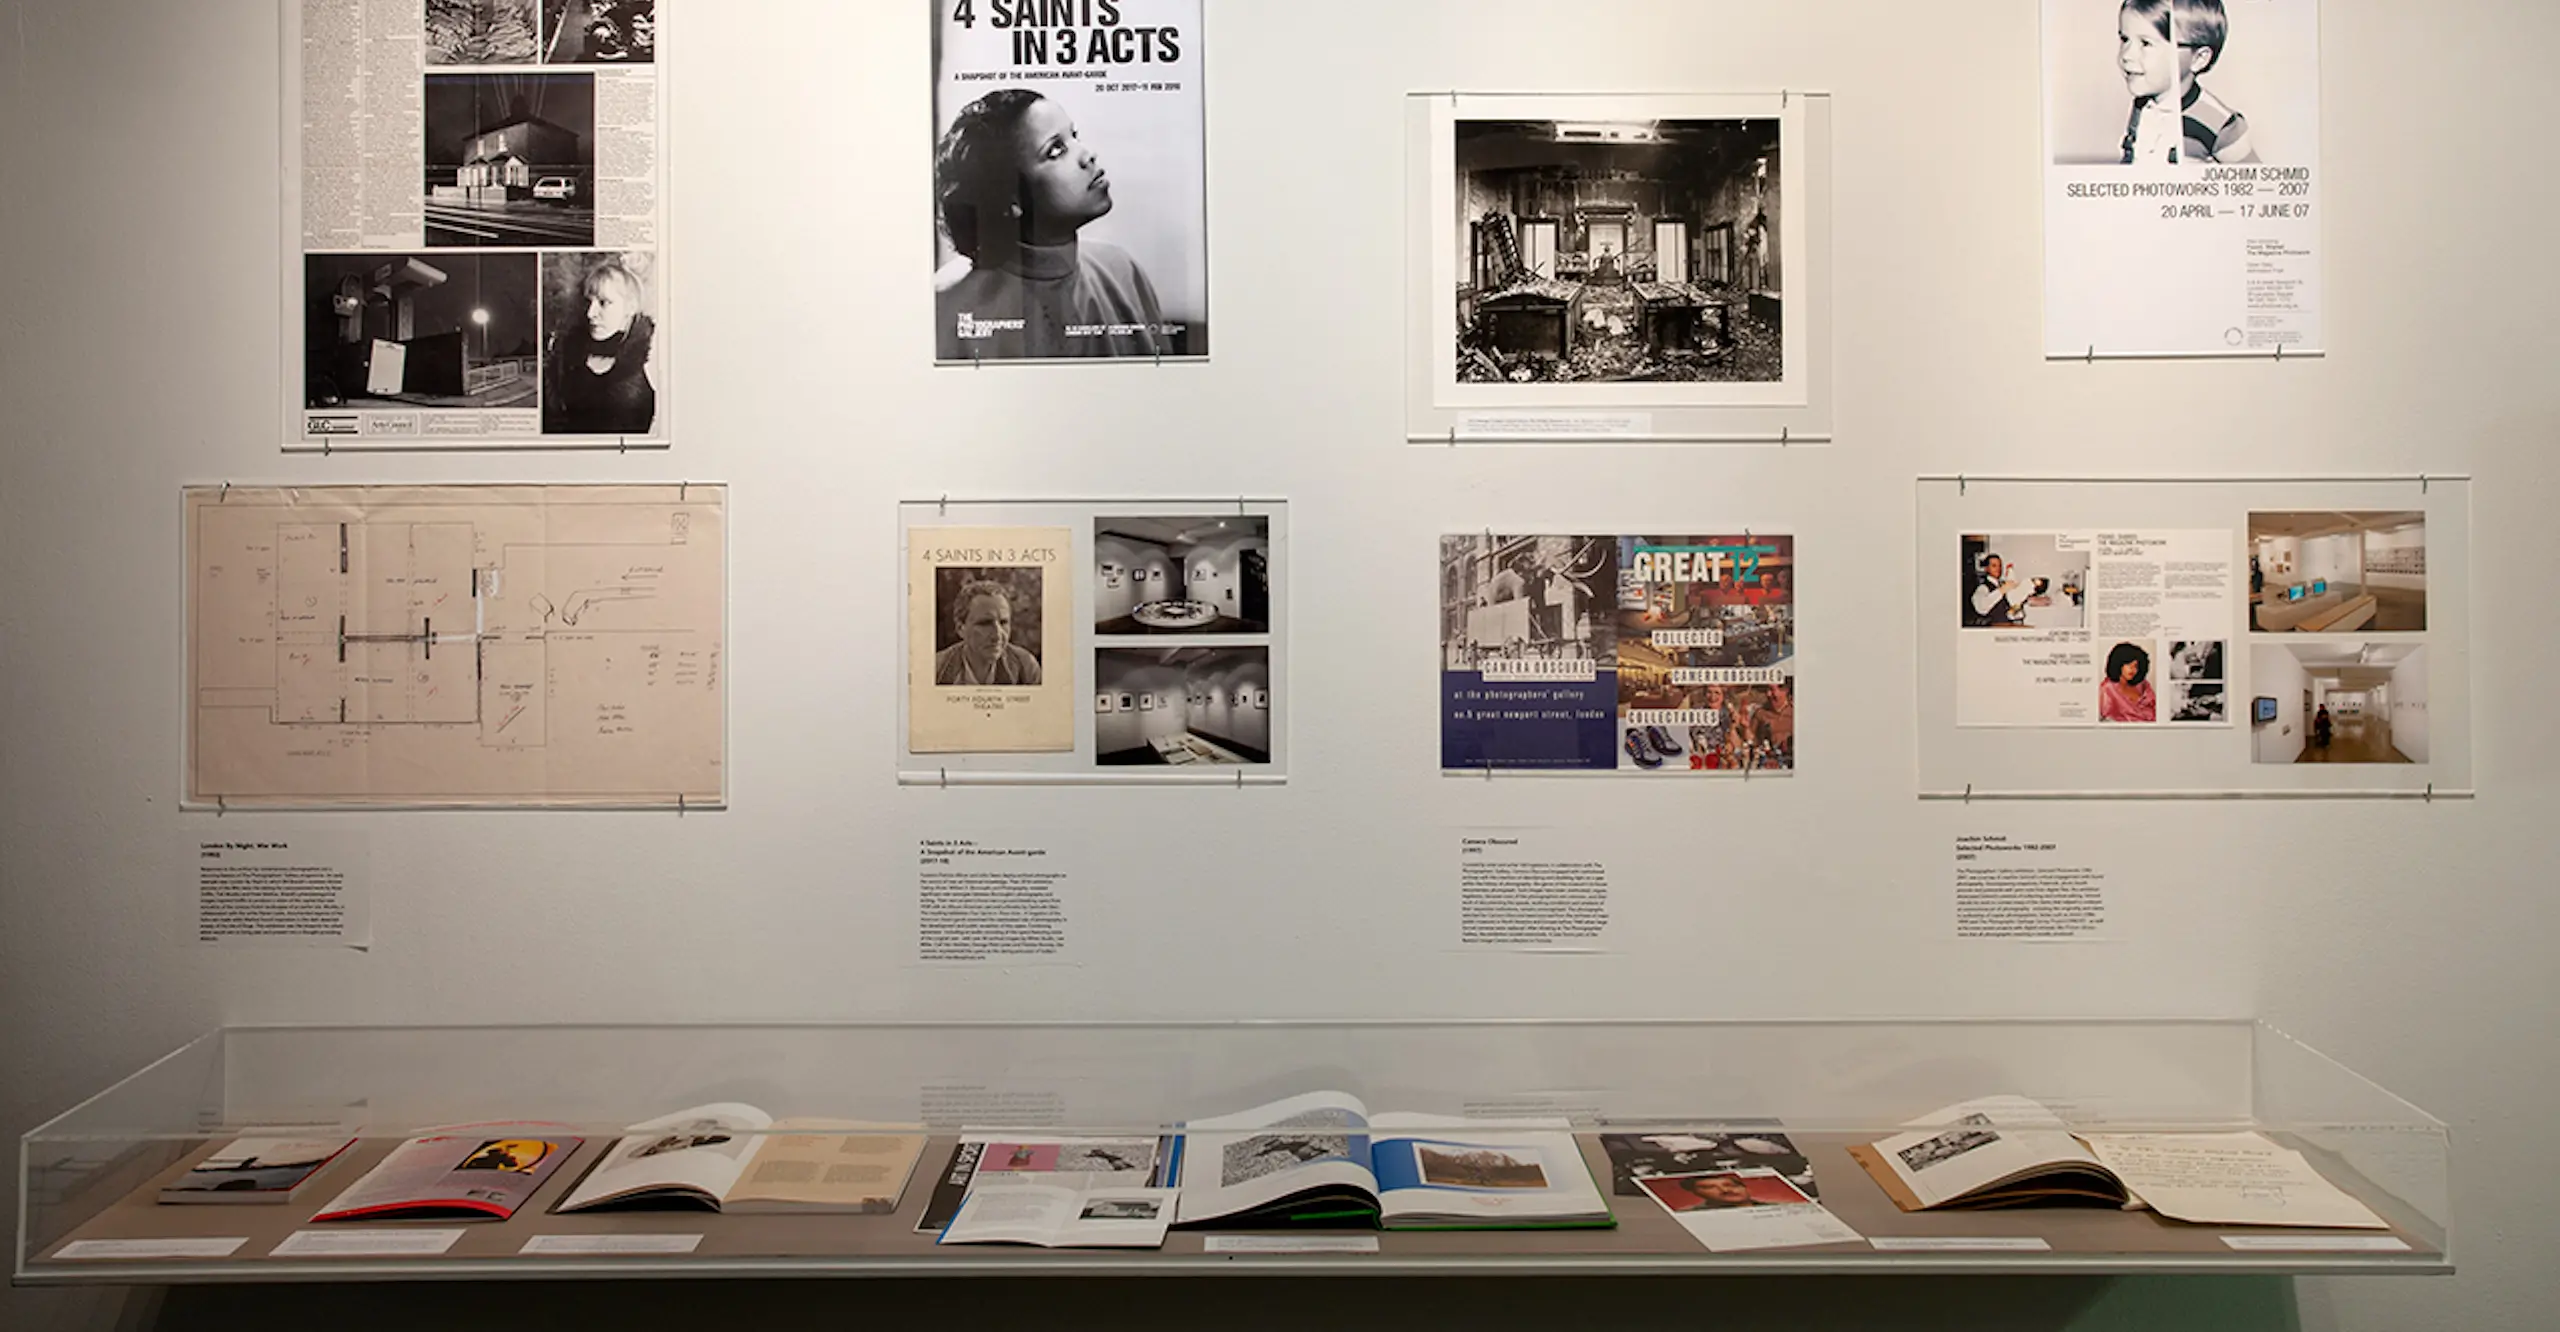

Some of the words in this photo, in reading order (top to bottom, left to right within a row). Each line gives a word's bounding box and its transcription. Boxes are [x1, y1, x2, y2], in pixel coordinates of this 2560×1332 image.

[953, 0, 975, 28] 4
[991, 0, 1120, 28] SAINTS
[1013, 30, 1047, 65] IN
[1056, 29, 1076, 64] 3
[1086, 27, 1180, 63] ACTS
[1010, 72, 1022, 80] THE
[2201, 168, 2257, 181] JOACHIM
[2260, 167, 2309, 180] SCHMID
[2067, 183, 2129, 197] SELECTED
[2133, 183, 2219, 197] PHOTOWORKS
[2224, 182, 2253, 196] 1982
[2279, 182, 2309, 195] 2007
[2161, 205, 2177, 218] 20
[2179, 205, 2214, 217] APRIL
[2240, 205, 2254, 217] 17
[2258, 204, 2290, 217] JUNE
[2294, 204, 2309, 217] 07
[922, 549, 930, 560] 4
[936, 548, 983, 561] SAINTS
[988, 549, 1003, 561] IN
[1008, 548, 1016, 561] 3
[1021, 548, 1057, 561] ACTS
[1634, 552, 1725, 583] GREAT
[1730, 551, 1760, 582] 12
[1654, 632, 1720, 644] COLLECTED
[1485, 661, 1530, 674] CAMERA
[1534, 661, 1594, 674] OBSCURED
[1674, 670, 1719, 682] CAMERA
[1723, 669, 1783, 682] OBSCURED
[1454, 691, 1463, 699] at
[1467, 690, 1481, 699] the
[1553, 690, 1584, 701] gallery
[1476, 711, 1500, 720] great
[1504, 710, 1539, 720] newport
[1575, 710, 1605, 719] london
[1628, 711, 1718, 724] COLLECTABLES
